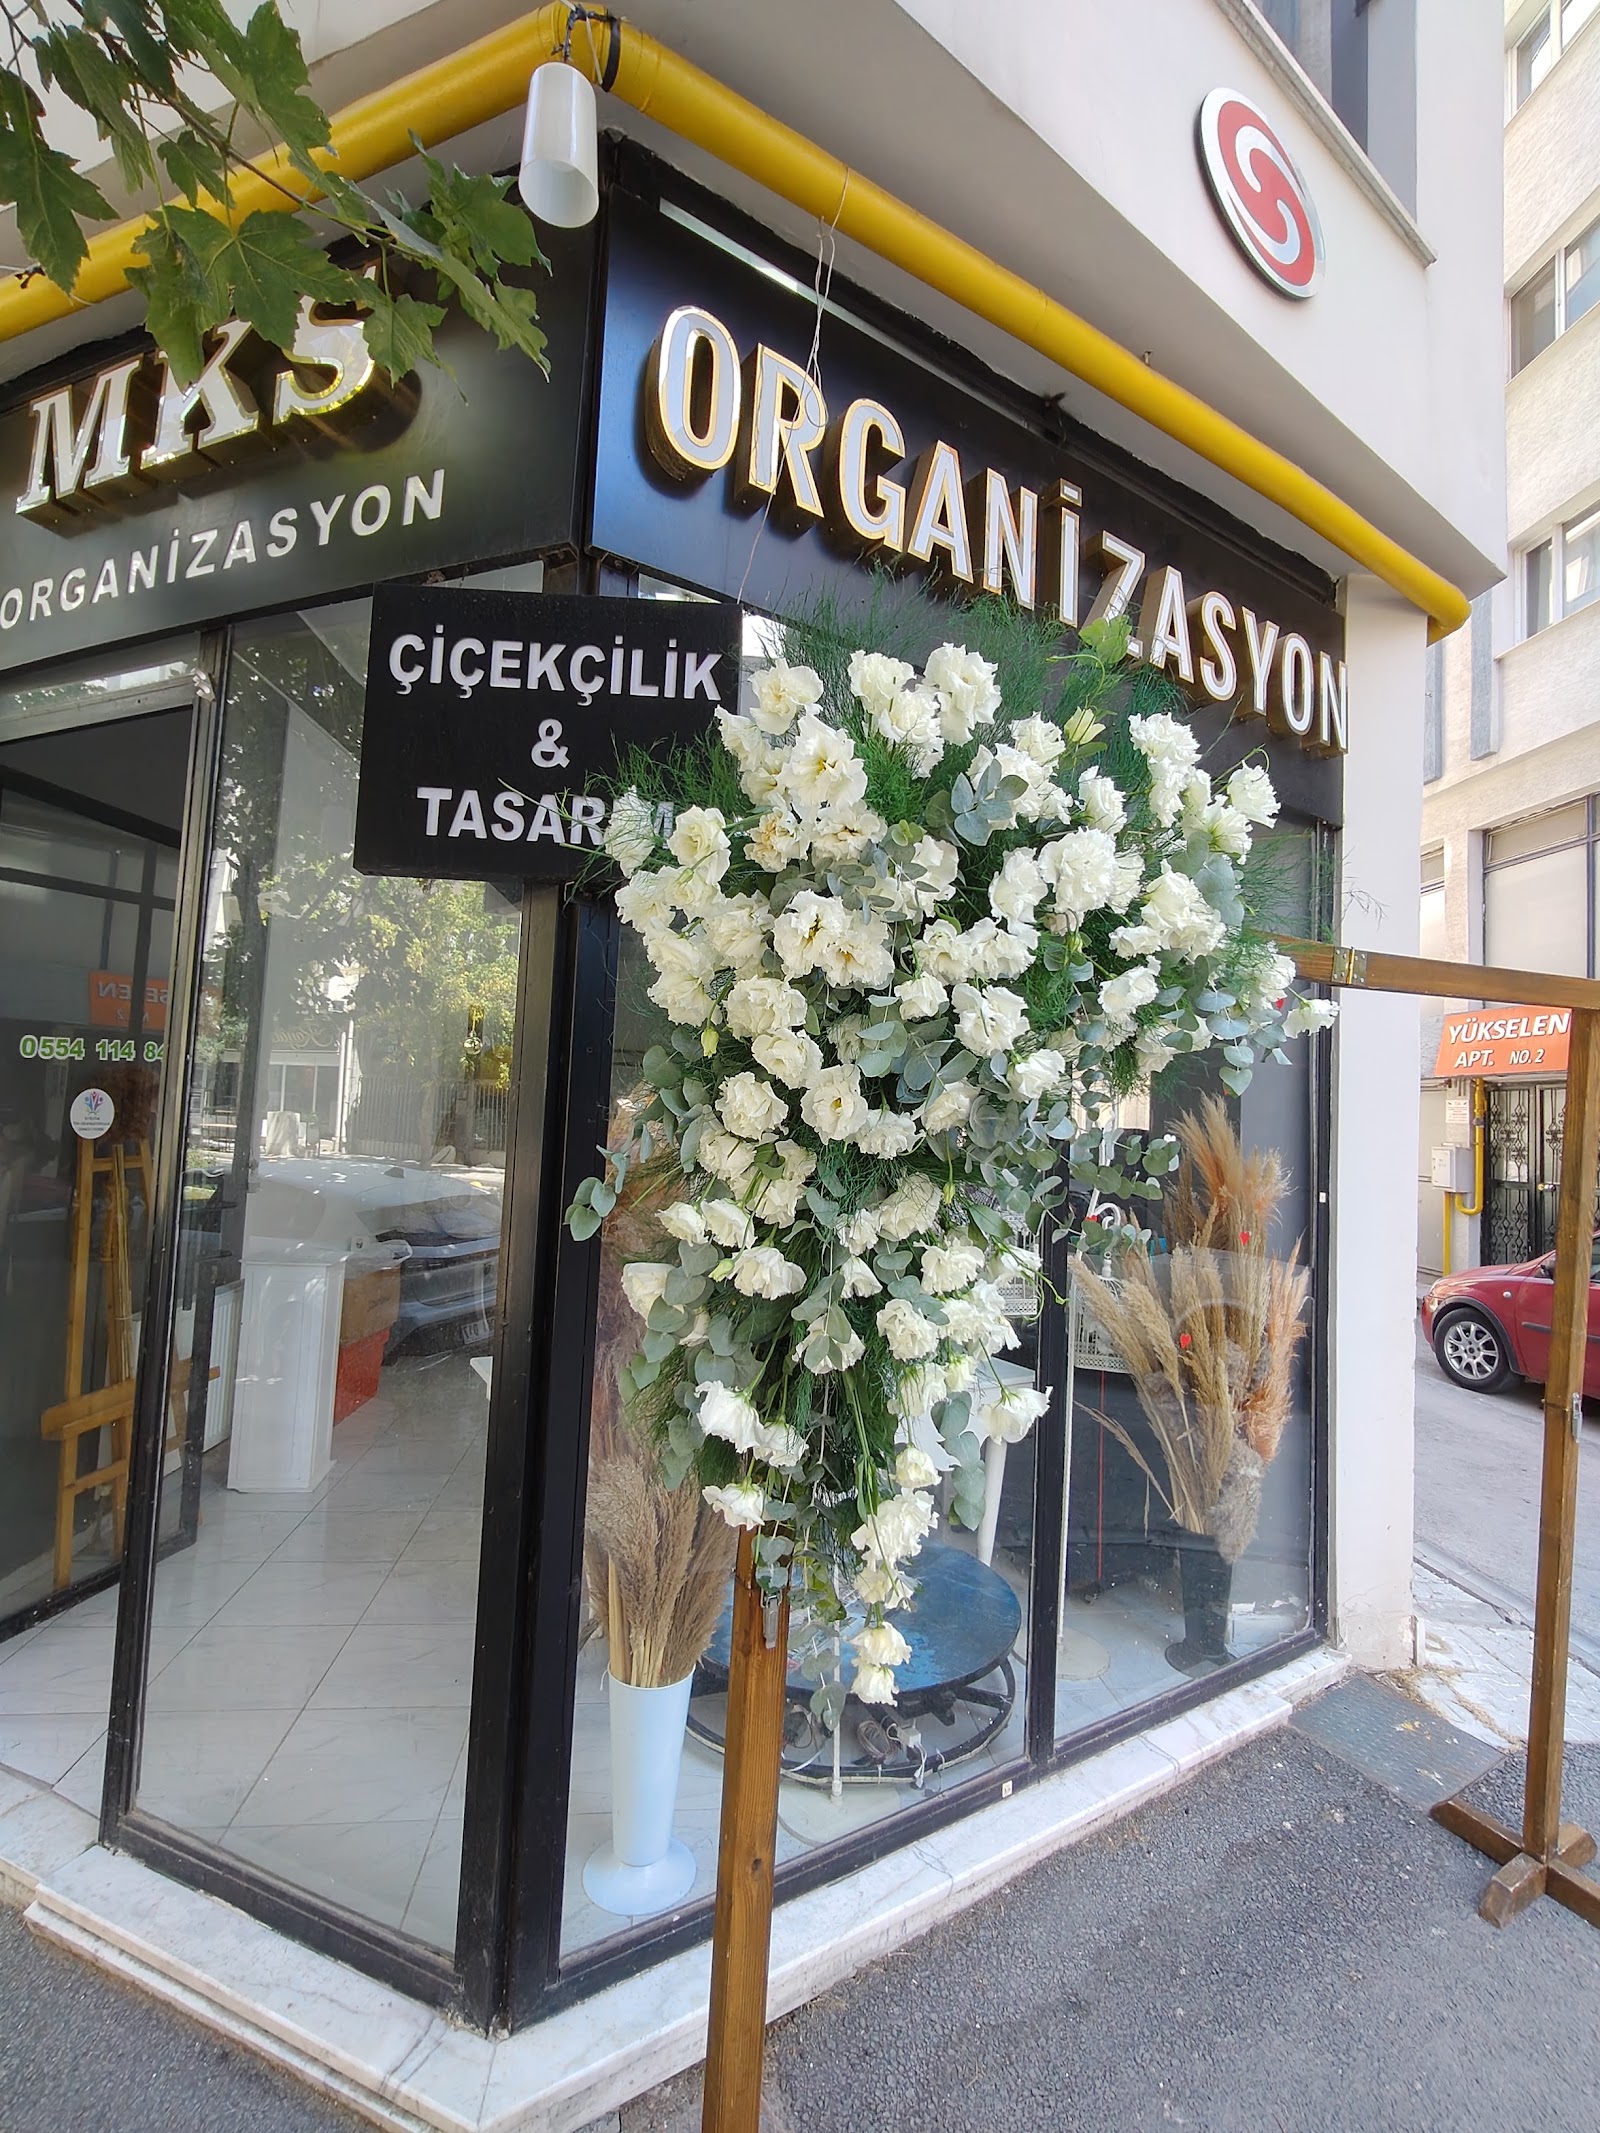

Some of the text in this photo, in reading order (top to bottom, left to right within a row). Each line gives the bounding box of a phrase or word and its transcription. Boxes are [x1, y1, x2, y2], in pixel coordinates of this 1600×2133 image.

[15, 263, 378, 514] MKS
[0, 468, 446, 629] ORGANİZASYON
[656, 304, 1348, 754] ORGANİZASYON
[388, 624, 723, 706] ÇİÇEKÇİLİK
[531, 719, 570, 768] &
[20, 1034, 85, 1062] 0554
[95, 1038, 137, 1062] 114
[1448, 1012, 1571, 1045] YÜKSELEN
[1453, 1049, 1495, 1069] APT.
